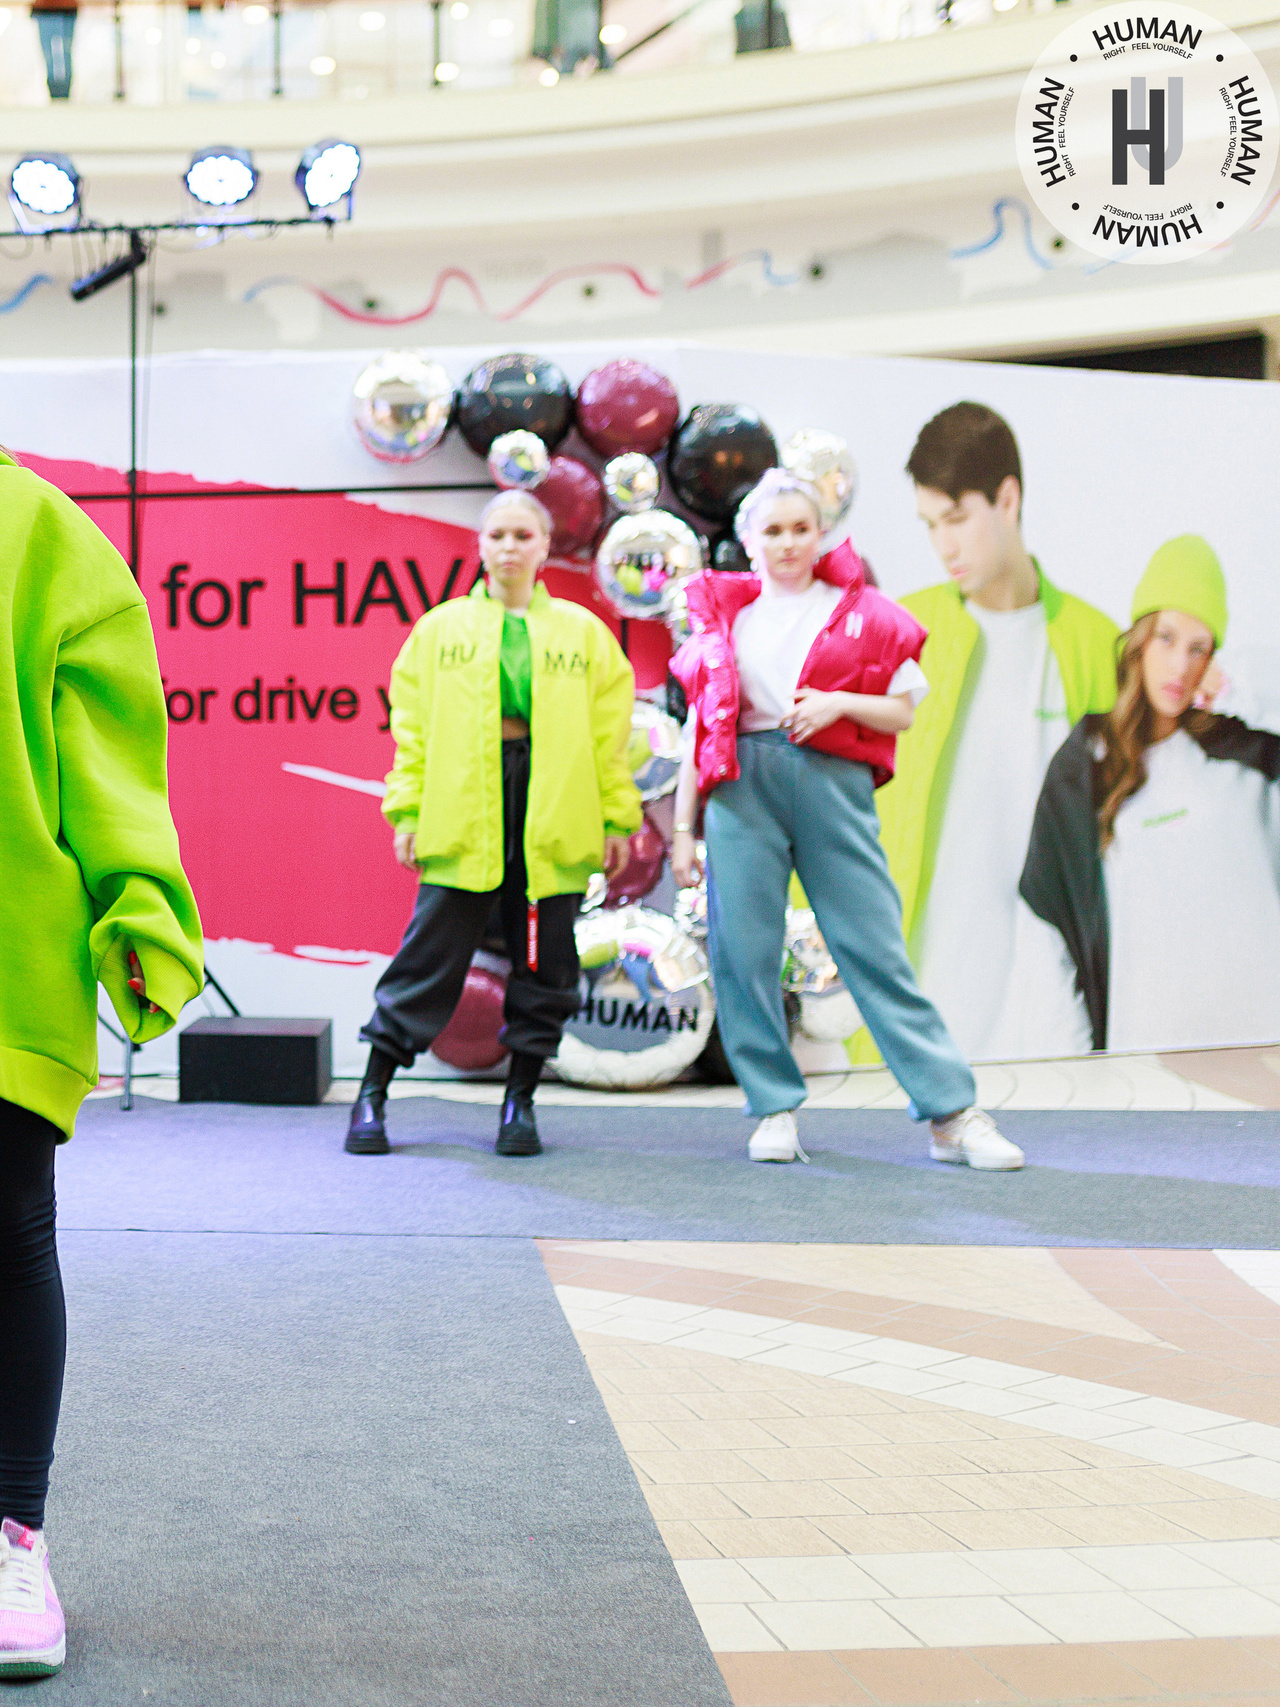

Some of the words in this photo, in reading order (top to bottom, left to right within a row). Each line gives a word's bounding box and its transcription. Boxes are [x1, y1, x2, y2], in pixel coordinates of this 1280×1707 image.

[162, 563, 265, 628] for
[439, 644, 476, 667] HU
[161, 677, 217, 722] or
[233, 677, 360, 722] drive
[572, 999, 698, 1032] HUMAN
